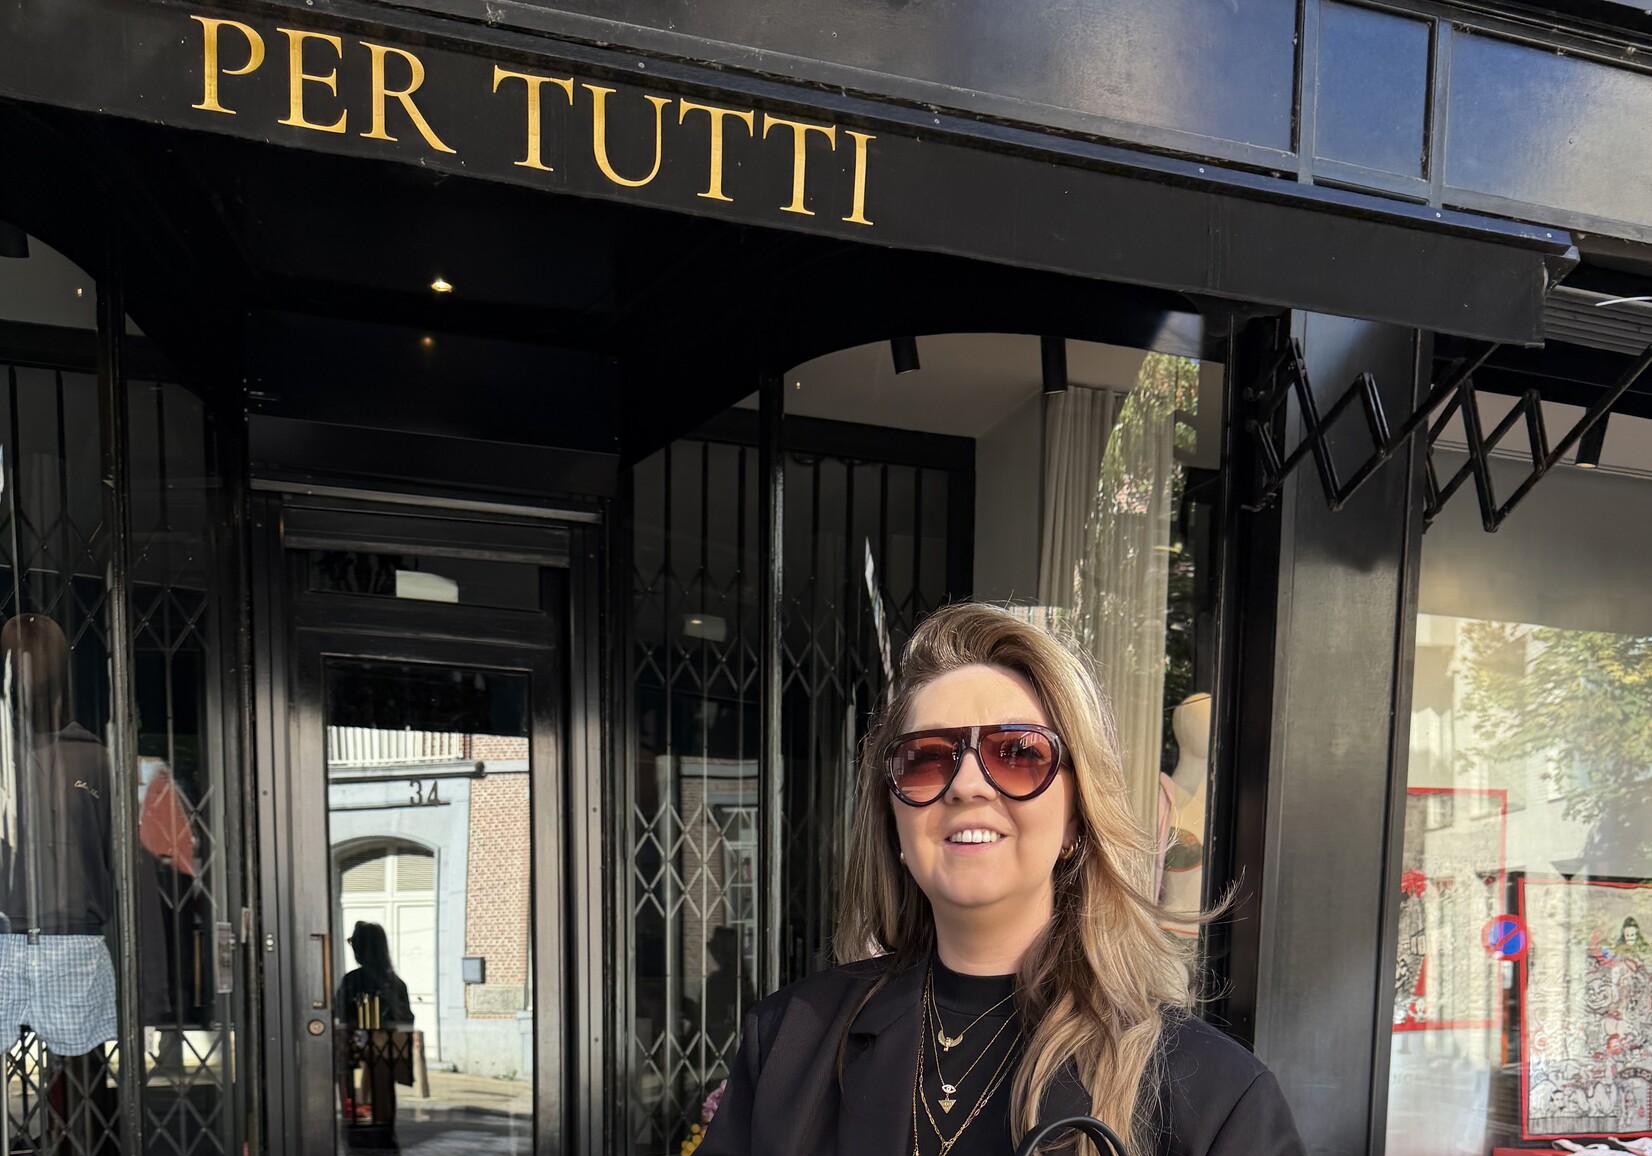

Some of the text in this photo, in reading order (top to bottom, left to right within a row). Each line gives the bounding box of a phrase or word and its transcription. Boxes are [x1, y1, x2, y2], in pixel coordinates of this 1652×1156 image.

[190, 15, 877, 226] PER TUTTI
[410, 778, 440, 806] 34
